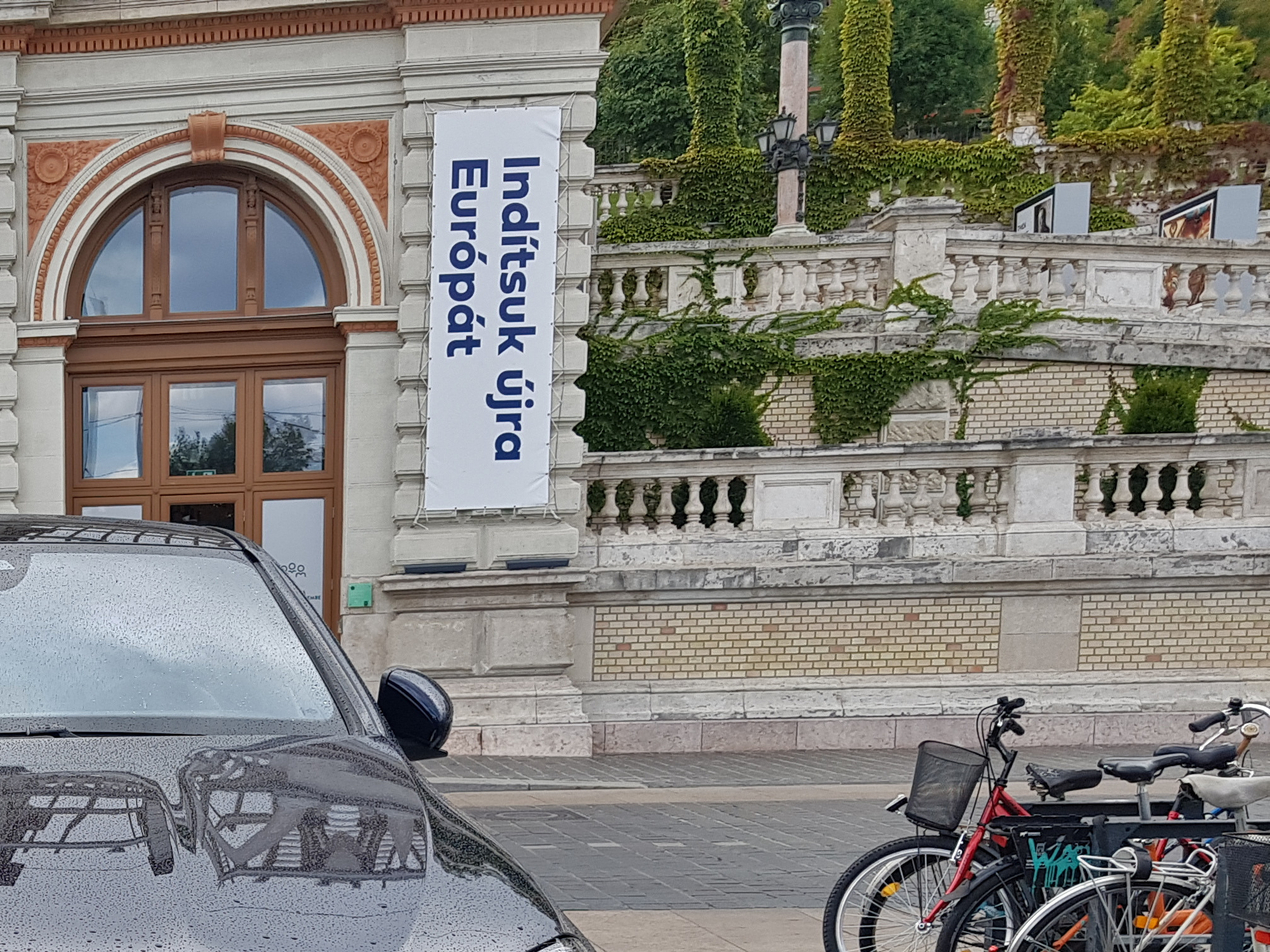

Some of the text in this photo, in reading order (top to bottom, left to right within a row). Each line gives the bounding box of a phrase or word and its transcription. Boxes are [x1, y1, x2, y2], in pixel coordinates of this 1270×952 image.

[438, 158, 490, 358] Európát
[485, 156, 541, 461] Indítsuk újra
